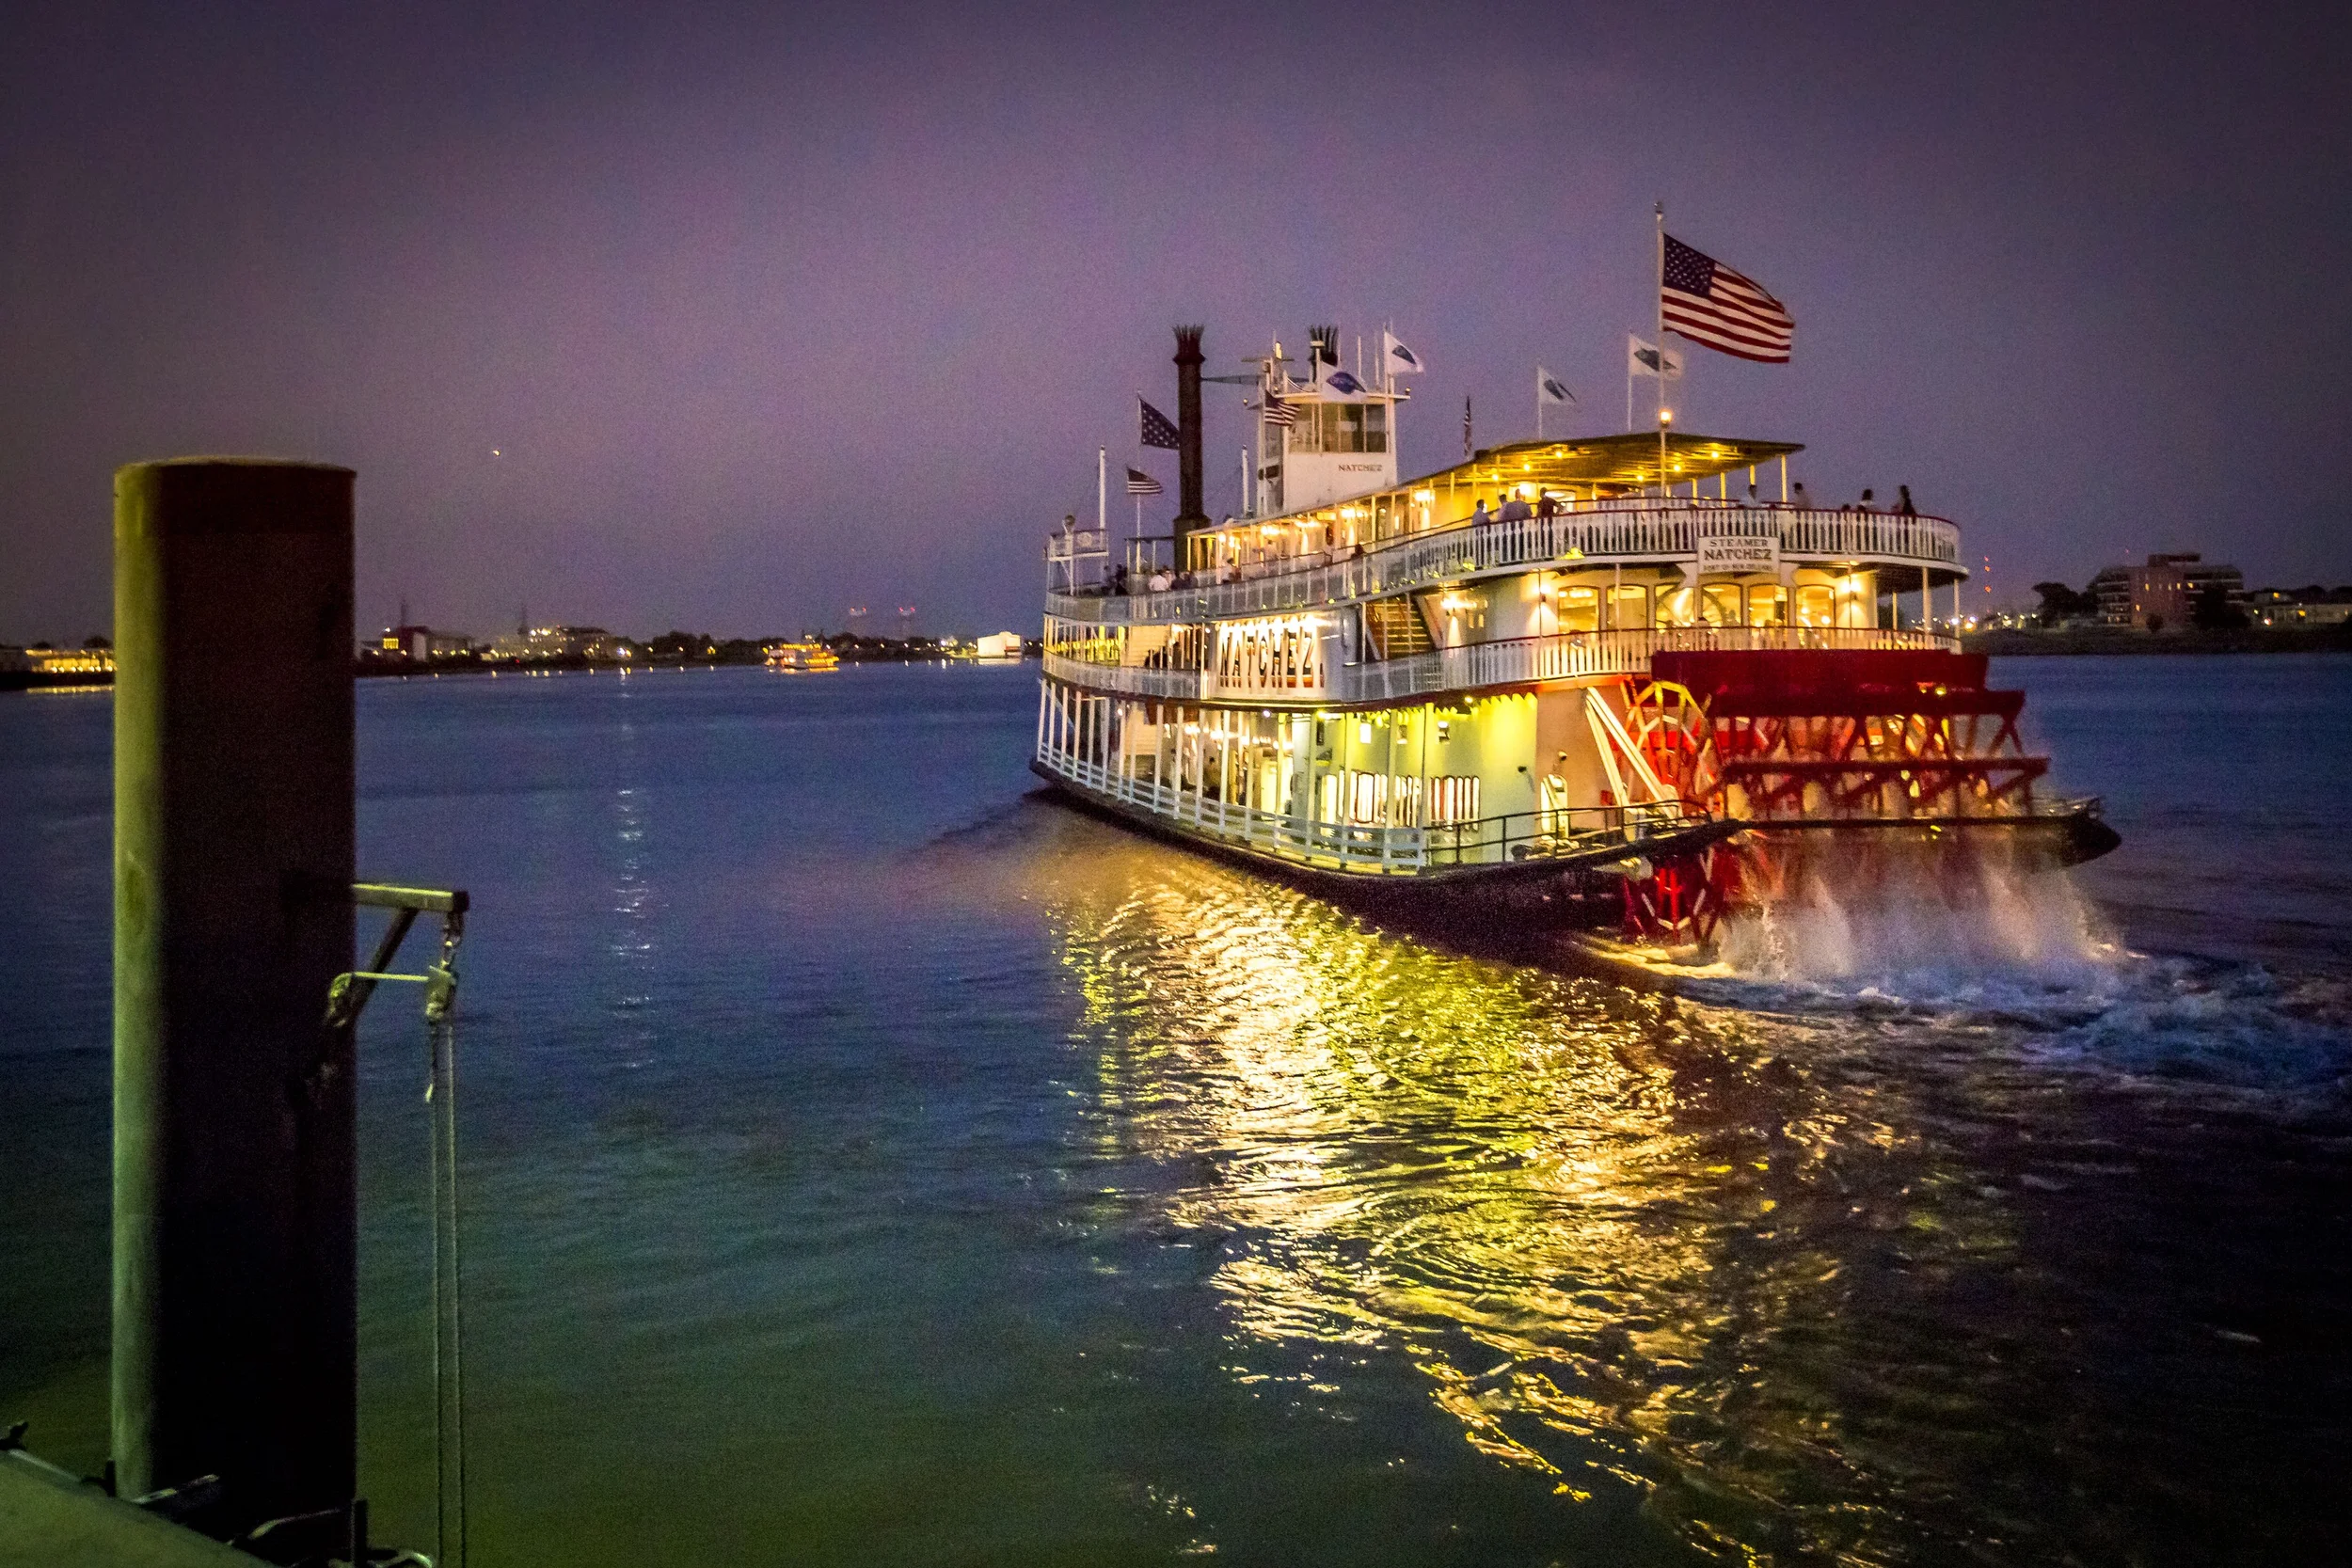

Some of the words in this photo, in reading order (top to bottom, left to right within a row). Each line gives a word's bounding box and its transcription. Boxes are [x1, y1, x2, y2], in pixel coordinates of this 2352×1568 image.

[1338, 464, 1382, 472] NATCHEZ
[1704, 548, 1772, 561] NATCHEZ
[1219, 626, 1315, 689] NATCHEZ
